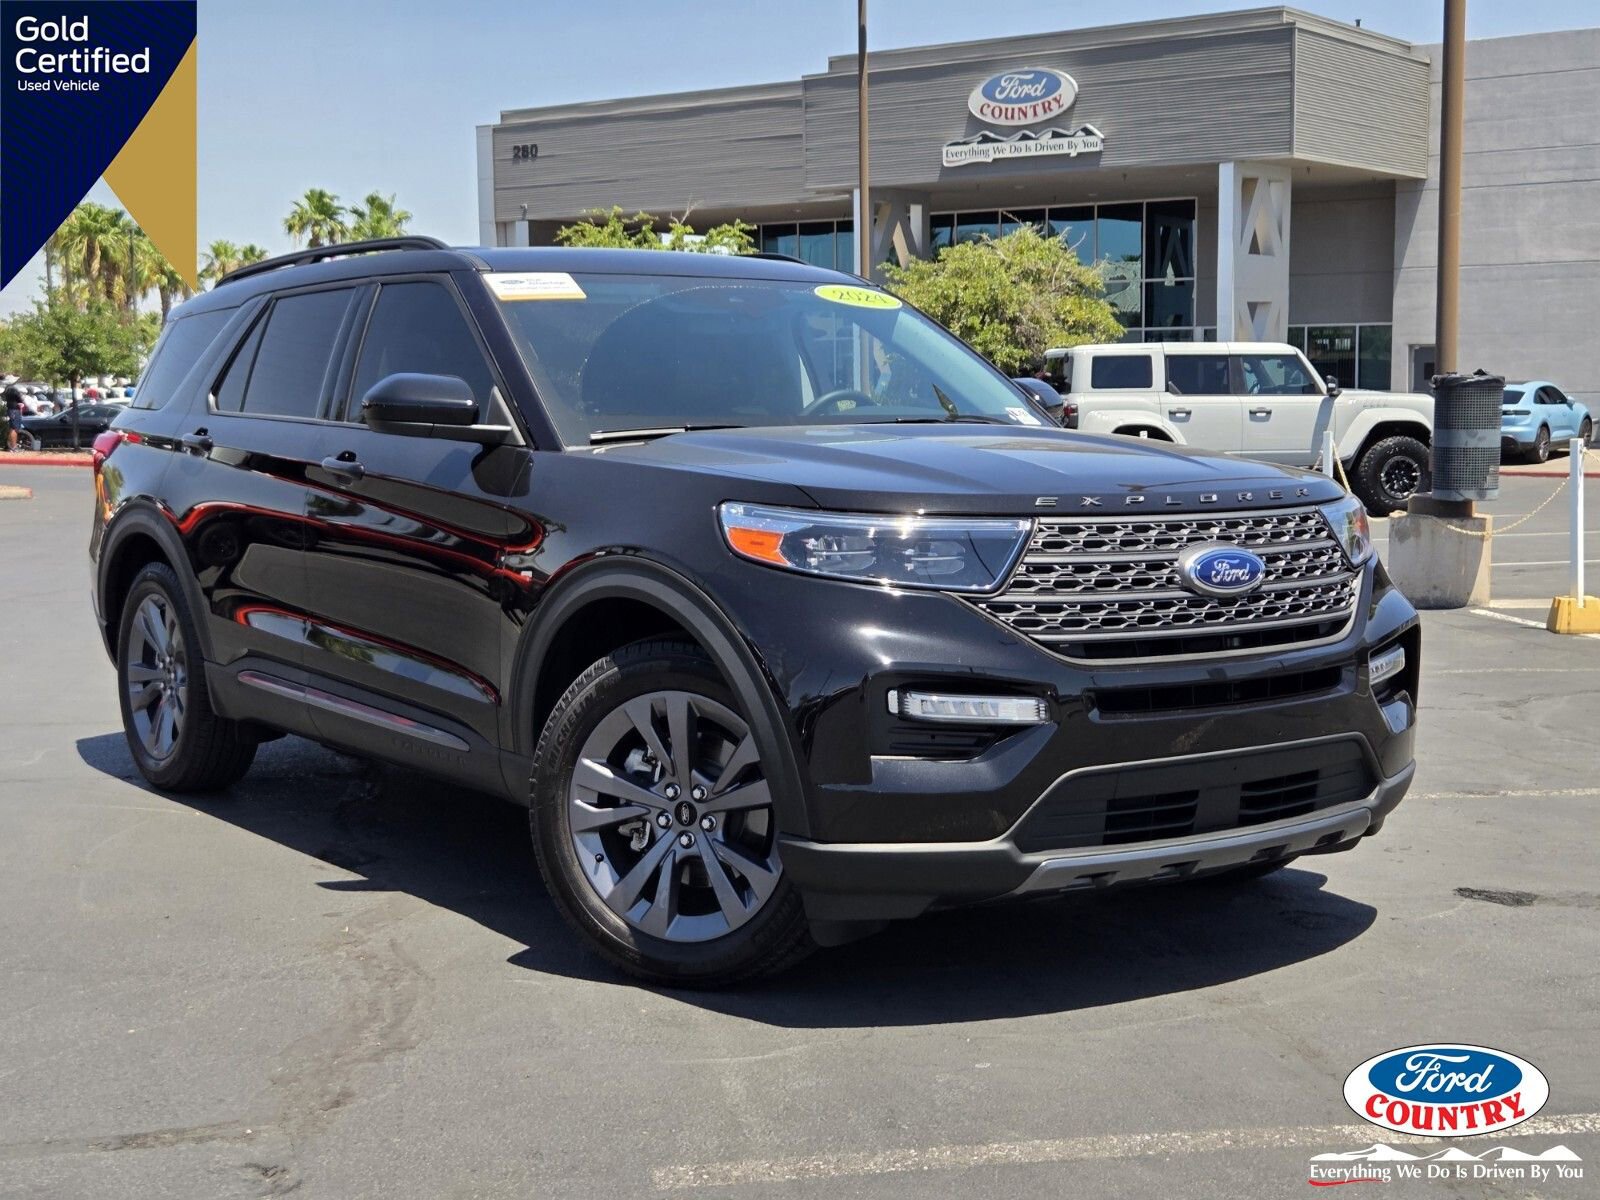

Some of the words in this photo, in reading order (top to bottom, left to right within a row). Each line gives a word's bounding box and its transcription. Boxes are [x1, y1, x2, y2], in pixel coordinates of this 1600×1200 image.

[994, 73, 1048, 99] Ford
[979, 94, 1064, 121] COUNTRY
[512, 144, 538, 159] 280
[945, 147, 990, 160] Everything
[992, 146, 1007, 155] We
[1009, 145, 1022, 154] Do
[1025, 144, 1032, 153] Is
[1035, 141, 1064, 152] Driven
[1067, 140, 1079, 151] By
[1082, 139, 1099, 149] You
[1034, 487, 1309, 507] EXPLORER
[1211, 559, 1250, 583] Ford
